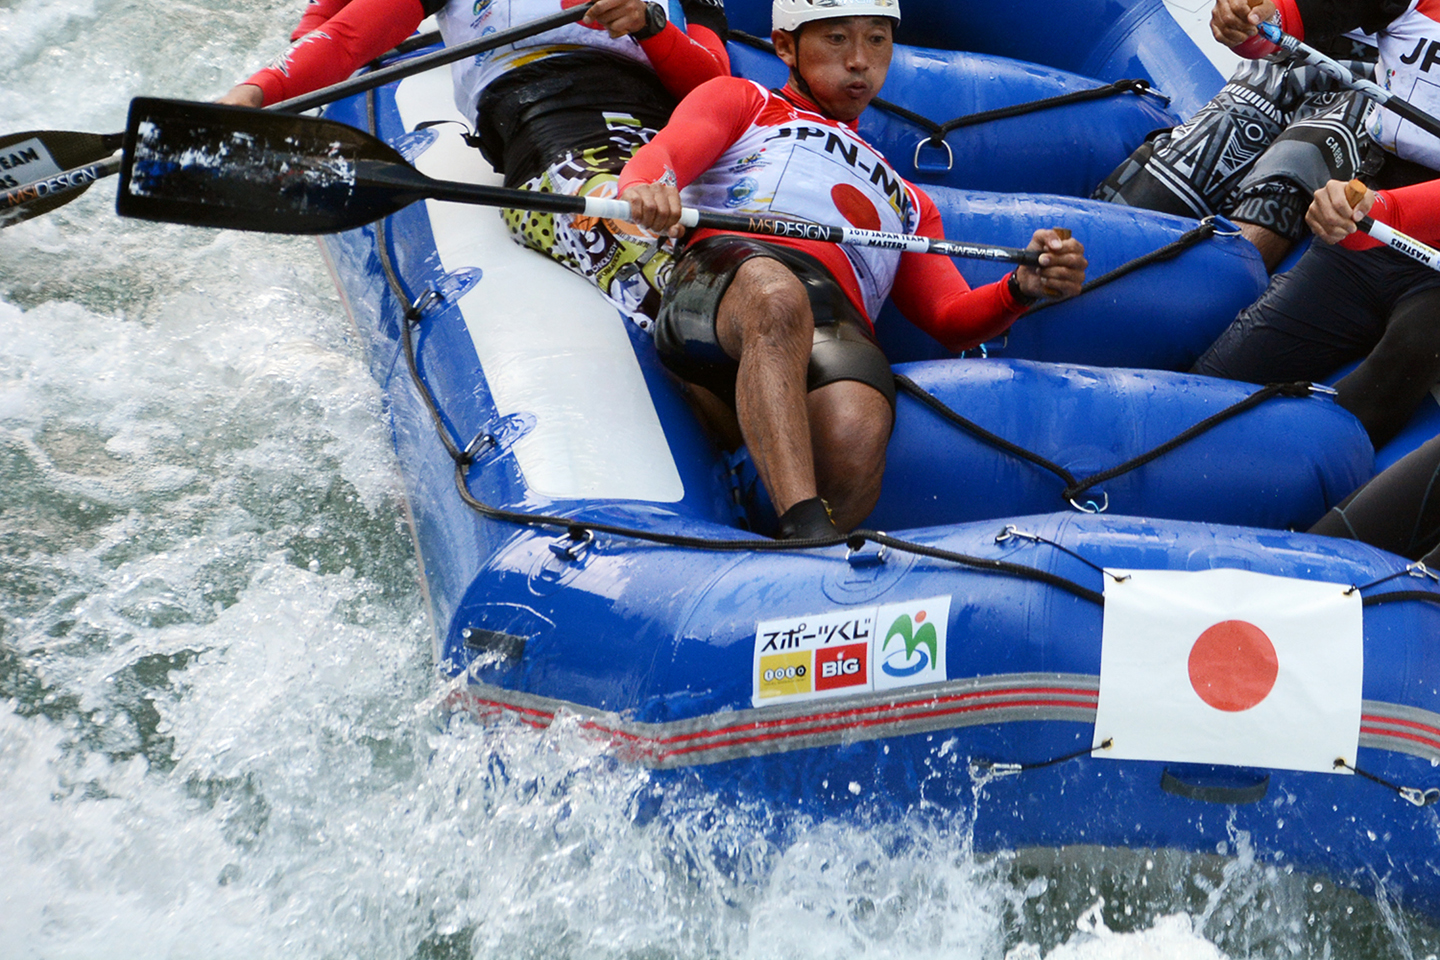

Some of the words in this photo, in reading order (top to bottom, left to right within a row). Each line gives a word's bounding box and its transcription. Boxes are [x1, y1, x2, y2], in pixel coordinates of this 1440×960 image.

[0, 146, 39, 172] EAM
[868, 239, 908, 251] MASTERS
[1390, 237, 1431, 264] MASTERS
[761, 618, 871, 653] スポーツくじ
[763, 664, 807, 683] toto
